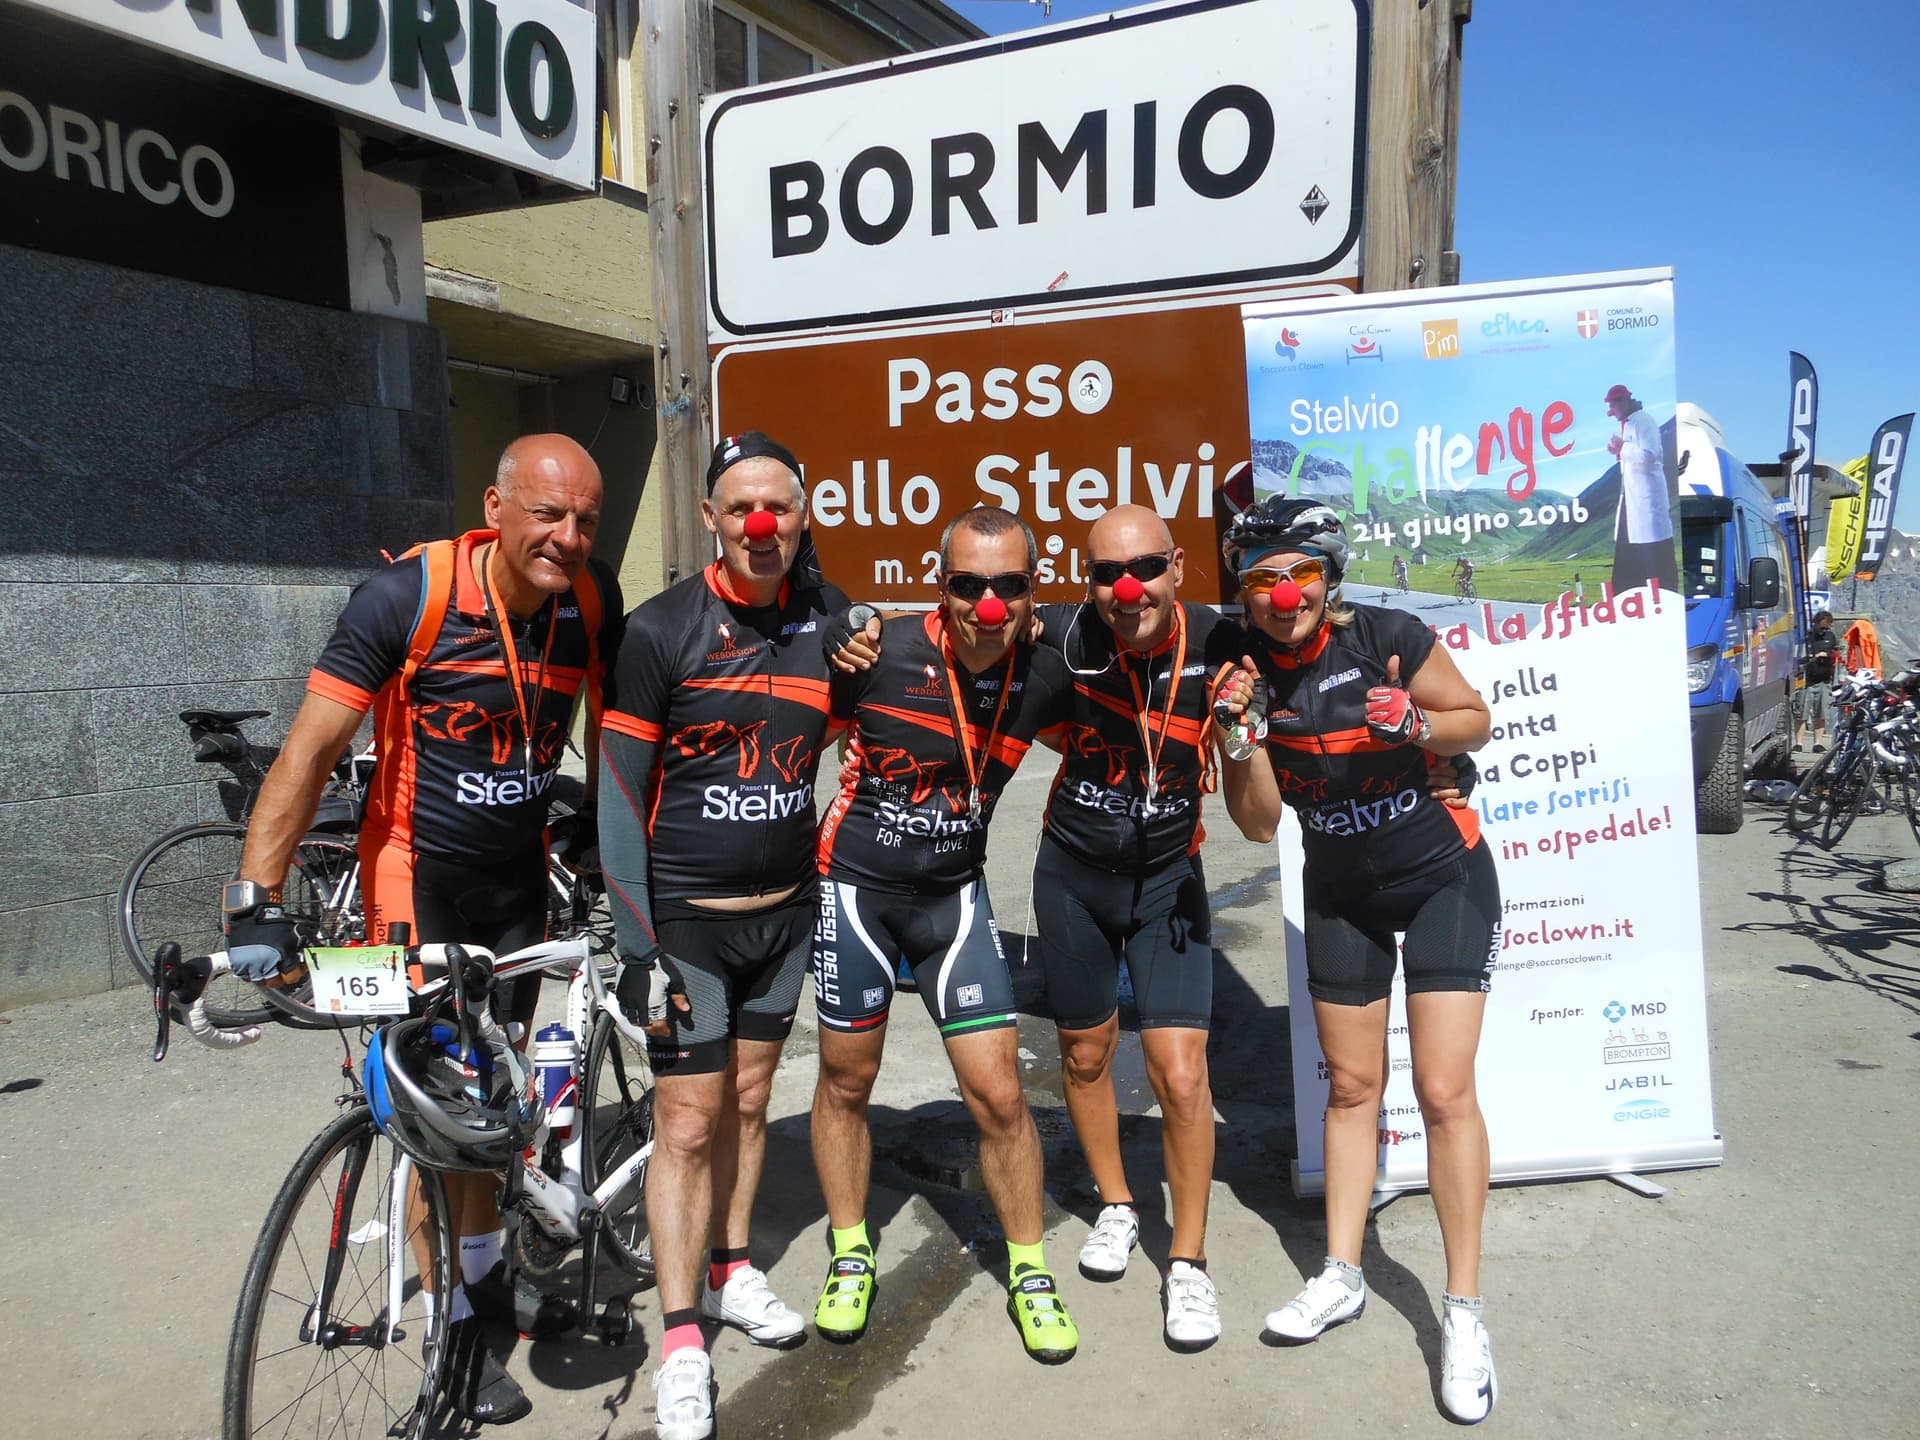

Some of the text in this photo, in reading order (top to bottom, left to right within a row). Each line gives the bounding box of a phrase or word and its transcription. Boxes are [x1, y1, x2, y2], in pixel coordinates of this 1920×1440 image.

[770, 84, 1275, 258] BORMIO
[1607, 315, 1659, 331] BORMIO
[888, 358, 1114, 428] Passo
[1289, 393, 1399, 437] Stelvio
[1289, 400, 1576, 518] Challenge
[798, 459, 940, 528] ello
[1862, 431, 1903, 561] HEAD
[1353, 498, 1589, 550] 24 giugno 2016
[874, 558, 914, 585] m.
[1483, 602, 1527, 646] la
[1541, 577, 1663, 641] sfida!
[706, 646, 758, 661] WEBDESIGN
[722, 637, 737, 651] JK
[924, 678, 942, 689] JK
[1491, 666, 1558, 704] sella
[1491, 713, 1558, 741] onta
[1510, 743, 1598, 782] Coppi
[702, 778, 812, 821] Stelvio
[740, 784, 762, 792] Passo
[886, 792, 906, 805] THE
[1476, 776, 1631, 826] lare sorrisi
[876, 827, 902, 848] FOR
[1502, 804, 1672, 861] in ospedale!
[1501, 894, 1586, 914] formazioni
[820, 881, 841, 1006] PASSO DELLO
[1502, 917, 1634, 950] soclown.it
[336, 975, 379, 997] 165
[1631, 1001, 1667, 1016] MSD
[1607, 1046, 1668, 1060] BROMPTON
[1605, 1074, 1673, 1091] JABIL
[837, 1260, 866, 1273] SIDI
[1022, 1278, 1051, 1292] SIDI
[1310, 1294, 1350, 1328] DIADORA
